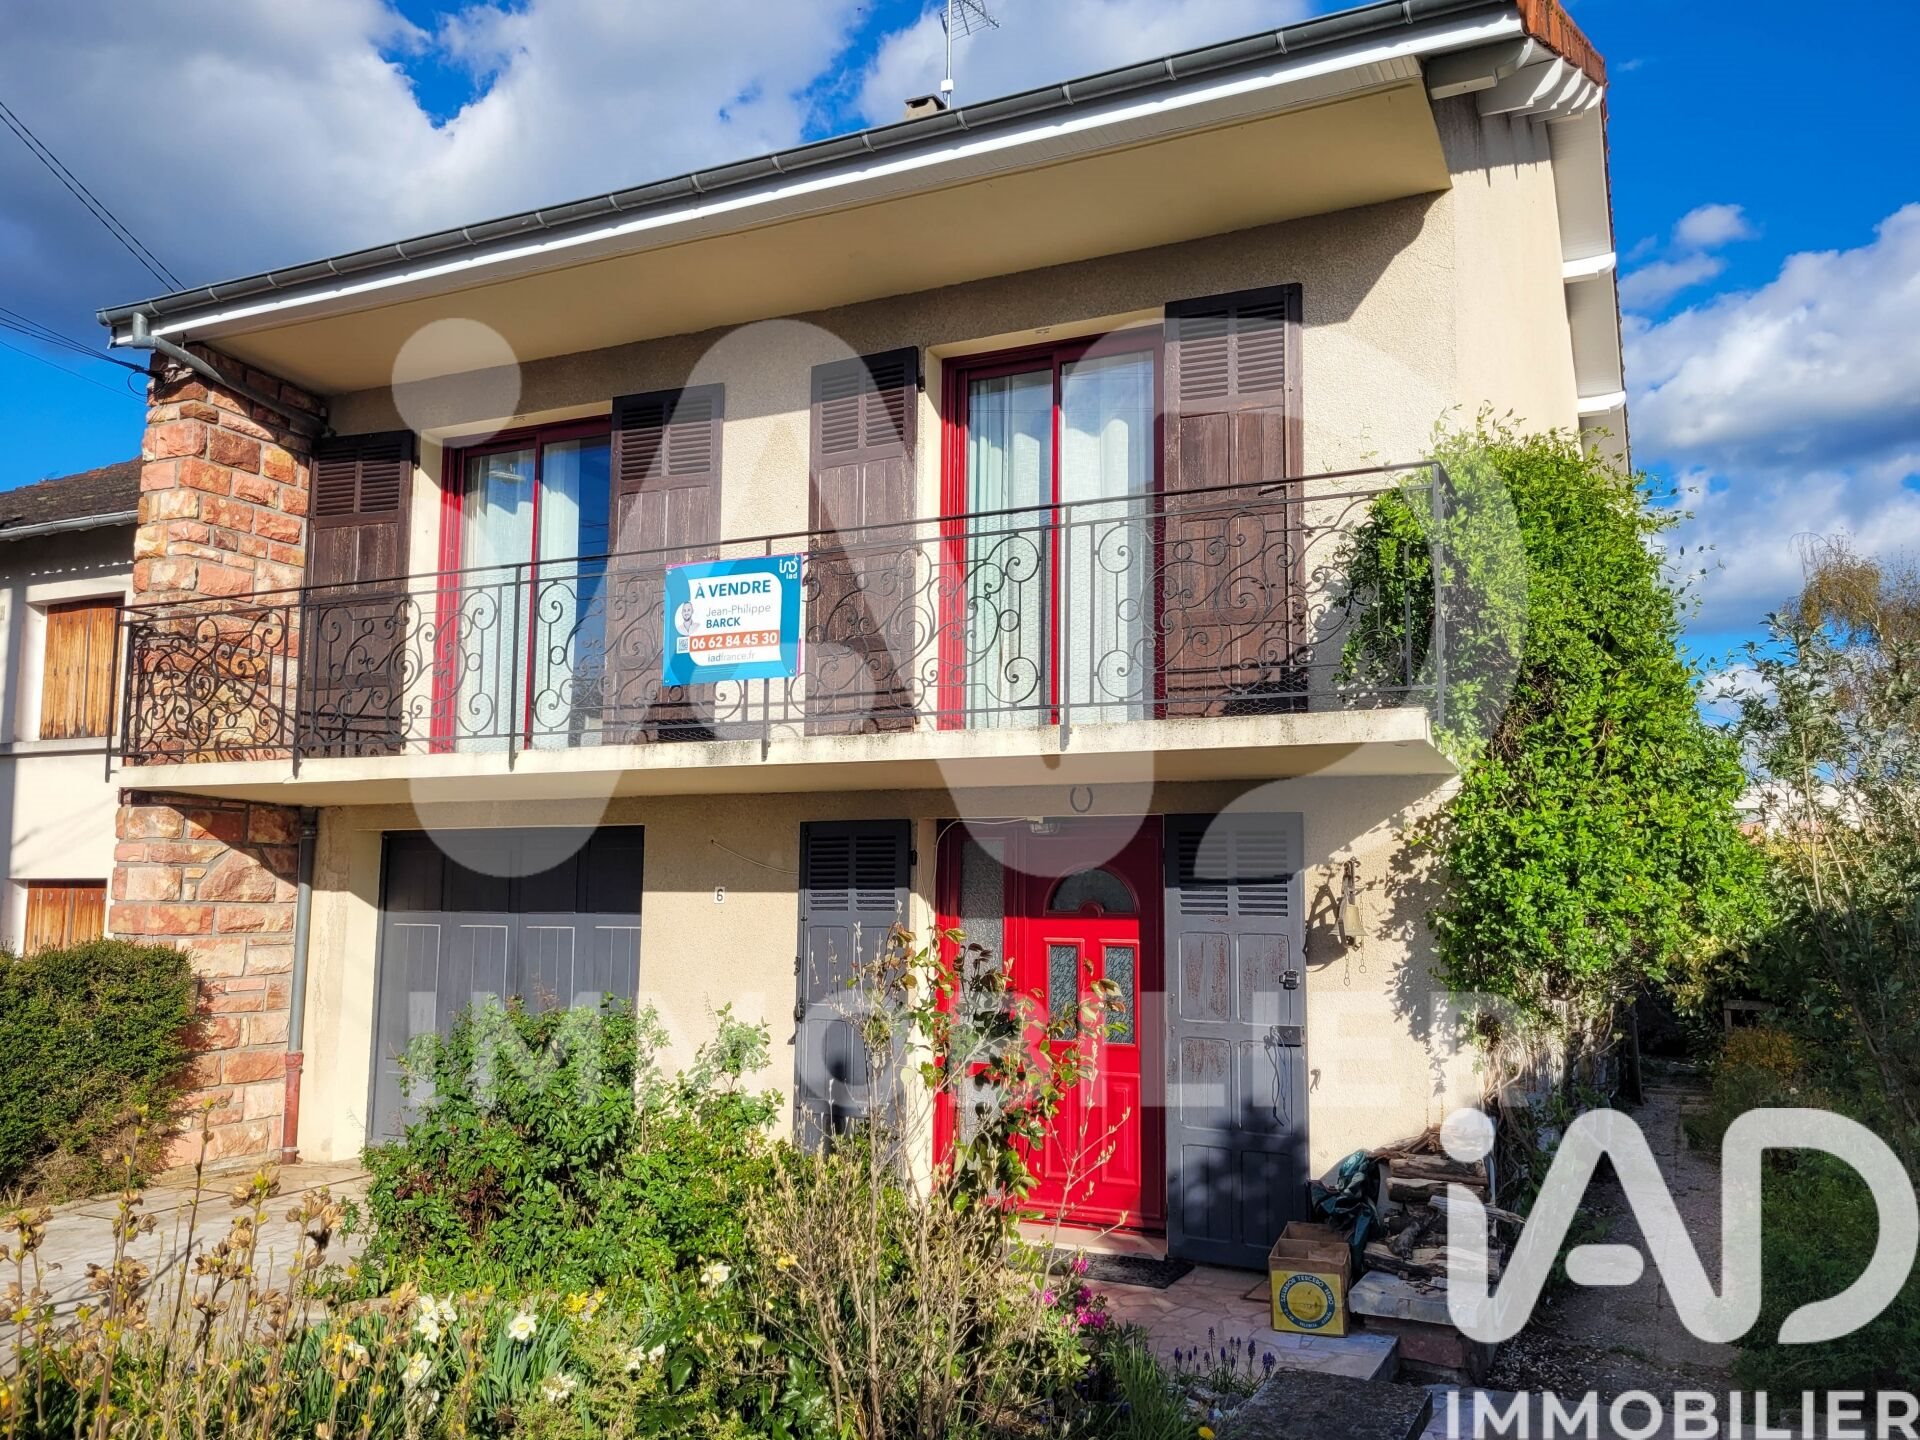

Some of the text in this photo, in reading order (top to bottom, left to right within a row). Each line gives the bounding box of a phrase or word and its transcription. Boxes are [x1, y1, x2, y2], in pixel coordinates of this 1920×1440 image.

[695, 579, 771, 599] À VENDRE
[705, 603, 771, 618] Jean-Philippe
[706, 617, 741, 629] BARCK
[691, 632, 777, 649] 06 62 84 45 30
[707, 651, 755, 663] iadfrance.fr
[717, 888, 723, 901] 6
